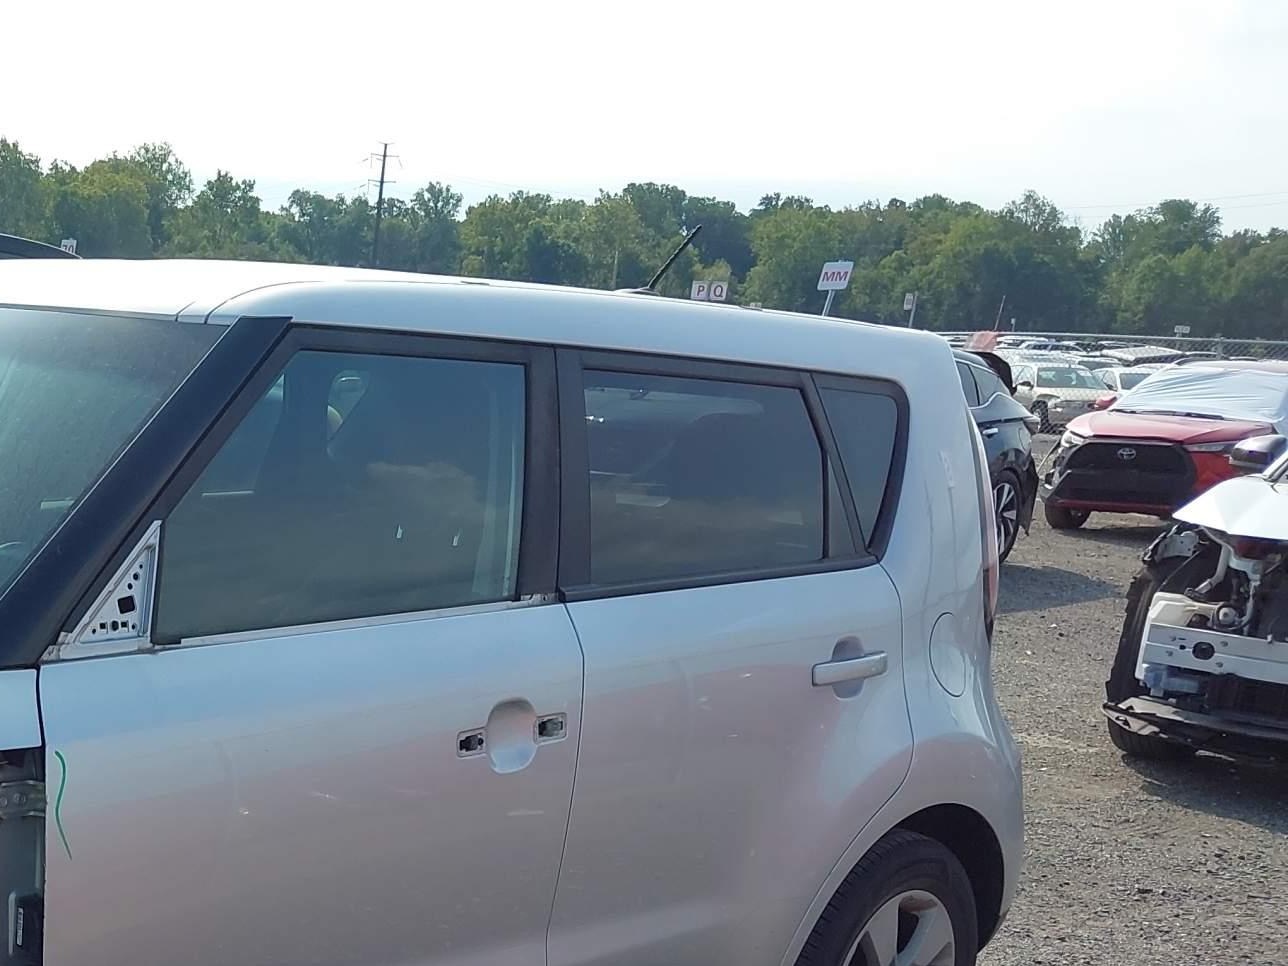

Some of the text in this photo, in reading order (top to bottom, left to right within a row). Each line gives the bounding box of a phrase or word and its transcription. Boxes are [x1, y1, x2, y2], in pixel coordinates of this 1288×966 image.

[822, 271, 849, 282] MM
[696, 285, 705, 297] P
[713, 284, 724, 298] Q
